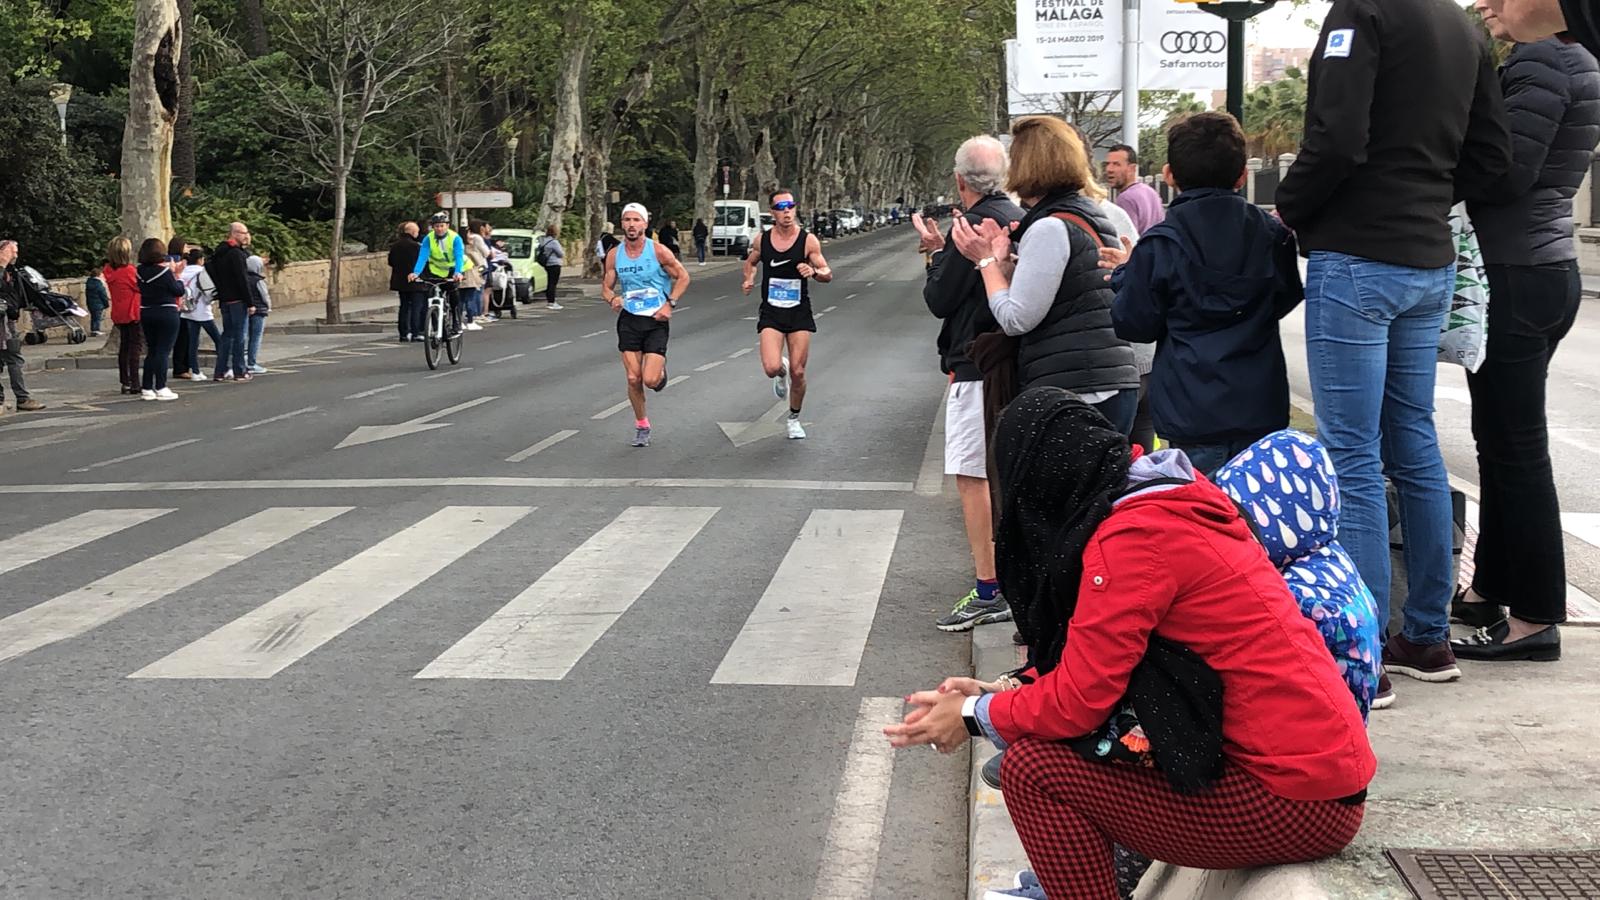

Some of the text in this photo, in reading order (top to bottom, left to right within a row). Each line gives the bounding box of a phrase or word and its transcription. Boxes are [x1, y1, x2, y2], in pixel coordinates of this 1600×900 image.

[1035, 0, 1086, 8] FESTIVAL
[1058, 35, 1086, 43] MARZO
[1087, 34, 1105, 42] 2019
[1159, 58, 1225, 68] Safamotor
[618, 264, 644, 274] nerja
